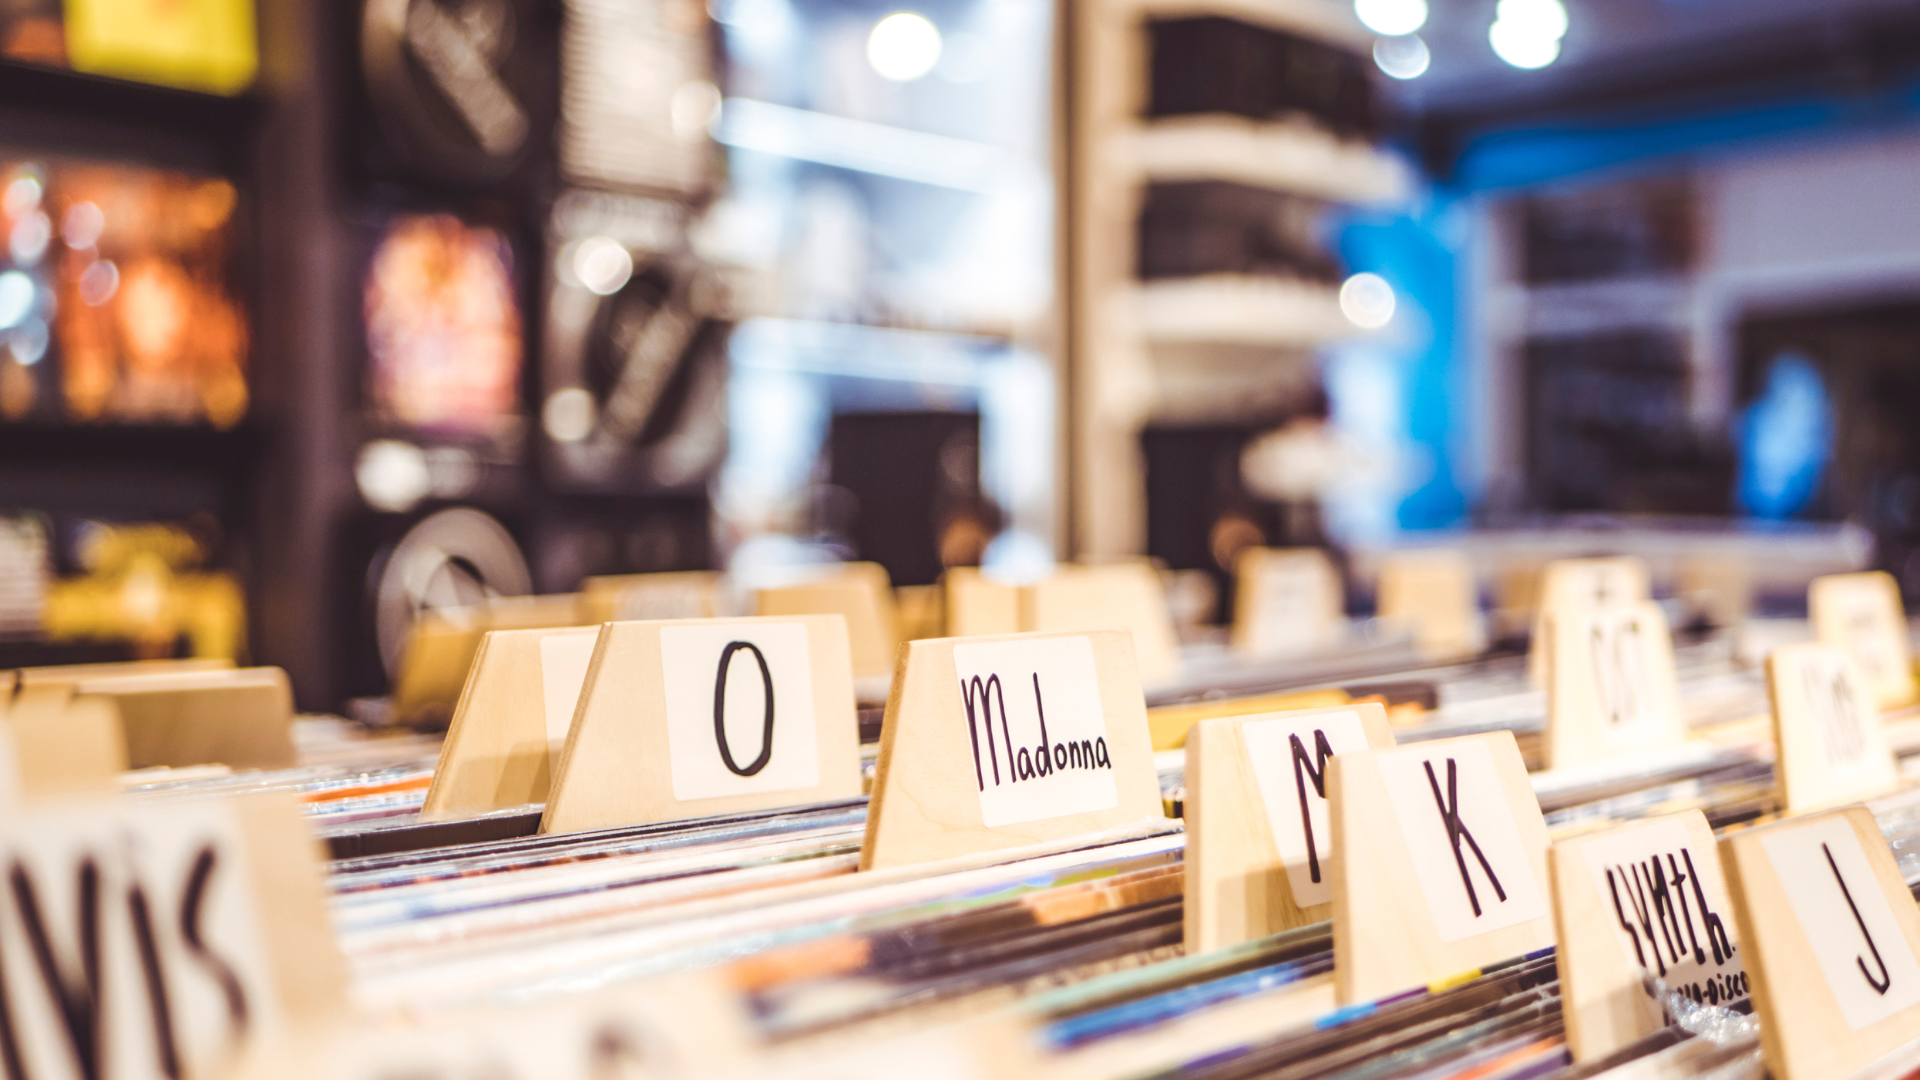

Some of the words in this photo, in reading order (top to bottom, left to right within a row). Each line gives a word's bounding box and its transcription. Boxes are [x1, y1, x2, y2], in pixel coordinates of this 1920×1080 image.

[961, 672, 1112, 792] Madonna
[1422, 757, 1508, 918] K
[1822, 842, 1892, 997] J
